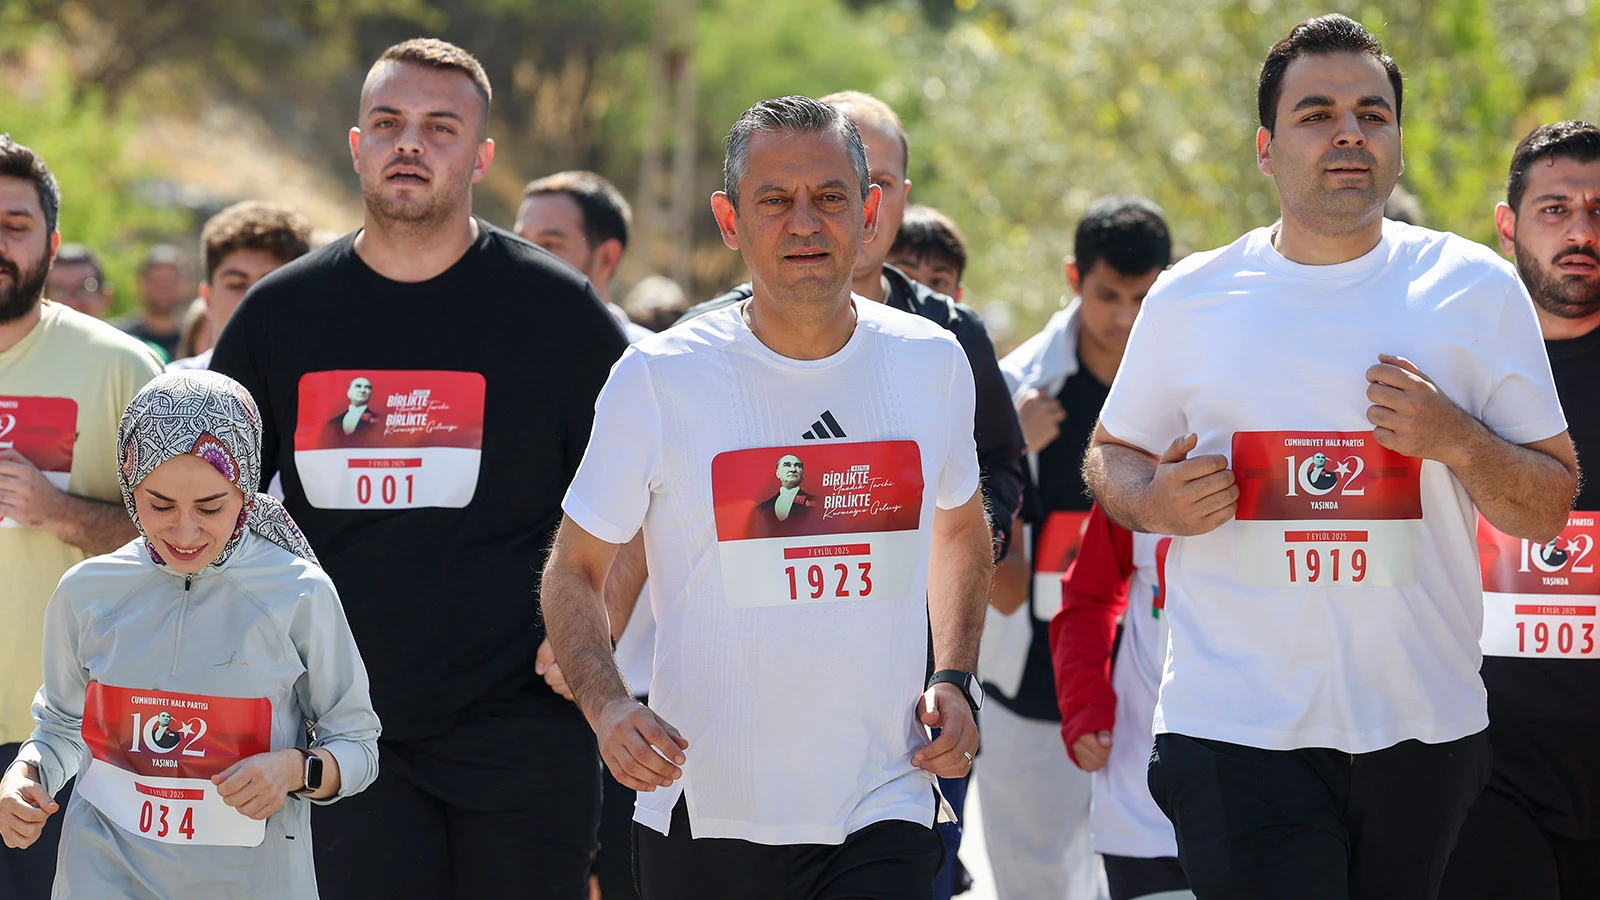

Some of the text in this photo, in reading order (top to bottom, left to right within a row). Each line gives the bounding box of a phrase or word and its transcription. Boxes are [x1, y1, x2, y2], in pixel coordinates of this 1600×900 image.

[386, 393, 429, 408] BİRLİKTE
[385, 411, 428, 427] BİRLİKTE
[1284, 438, 1364, 447] CUMHURİYET HALK PARTİSİ
[822, 469, 869, 487] BİRLİKTE
[357, 474, 413, 505] 001
[824, 491, 872, 509] BİRLİKTE
[1311, 501, 1339, 510] YAŞINDA
[1311, 532, 1330, 540] EYLÜL
[1332, 532, 1347, 540] 2025
[814, 547, 832, 556] EYLÜL
[834, 547, 850, 555] 2025
[1286, 549, 1367, 582] 1919
[785, 562, 873, 600] 1923
[1542, 577, 1569, 586] YAŞINDA
[1562, 607, 1577, 615] 2025
[1516, 622, 1595, 654] 1903
[131, 696, 209, 711] CUMHURİYET HALK PARTİSİ
[152, 758, 178, 768] YAŞINDA
[170, 790, 184, 799] 2025
[139, 800, 195, 840] 034
